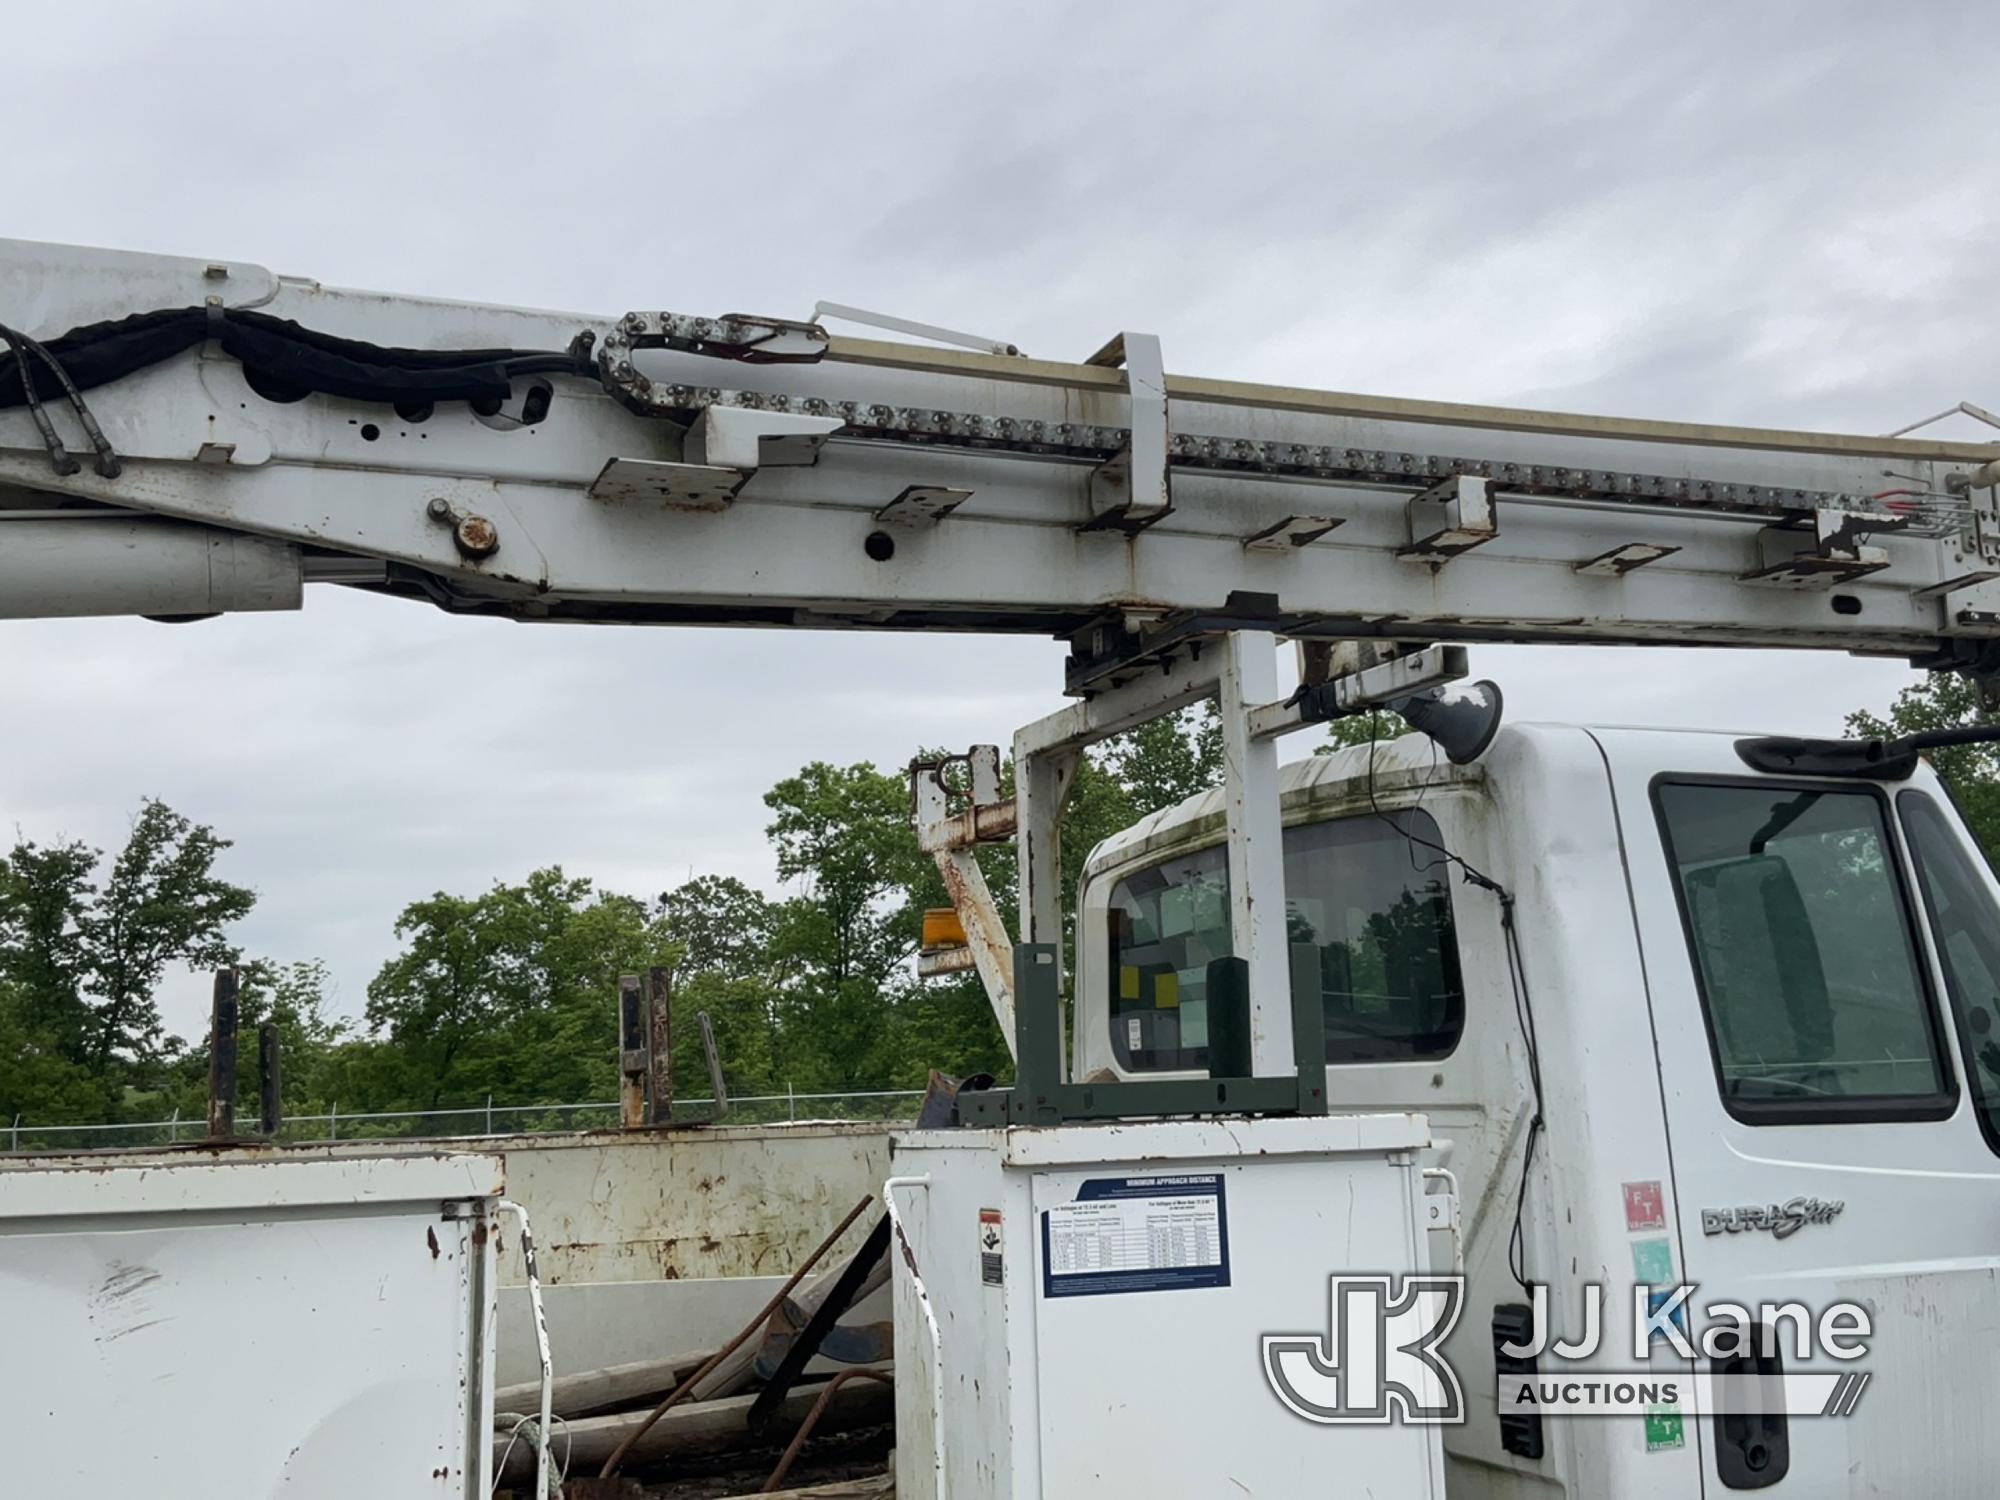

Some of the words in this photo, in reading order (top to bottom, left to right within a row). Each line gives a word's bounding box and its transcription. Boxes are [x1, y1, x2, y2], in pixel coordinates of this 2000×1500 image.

[1126, 1178, 1155, 1187] MINIMUM
[1156, 1176, 1188, 1186] APPROACH
[1188, 1175, 1217, 1184] DISTANCE
